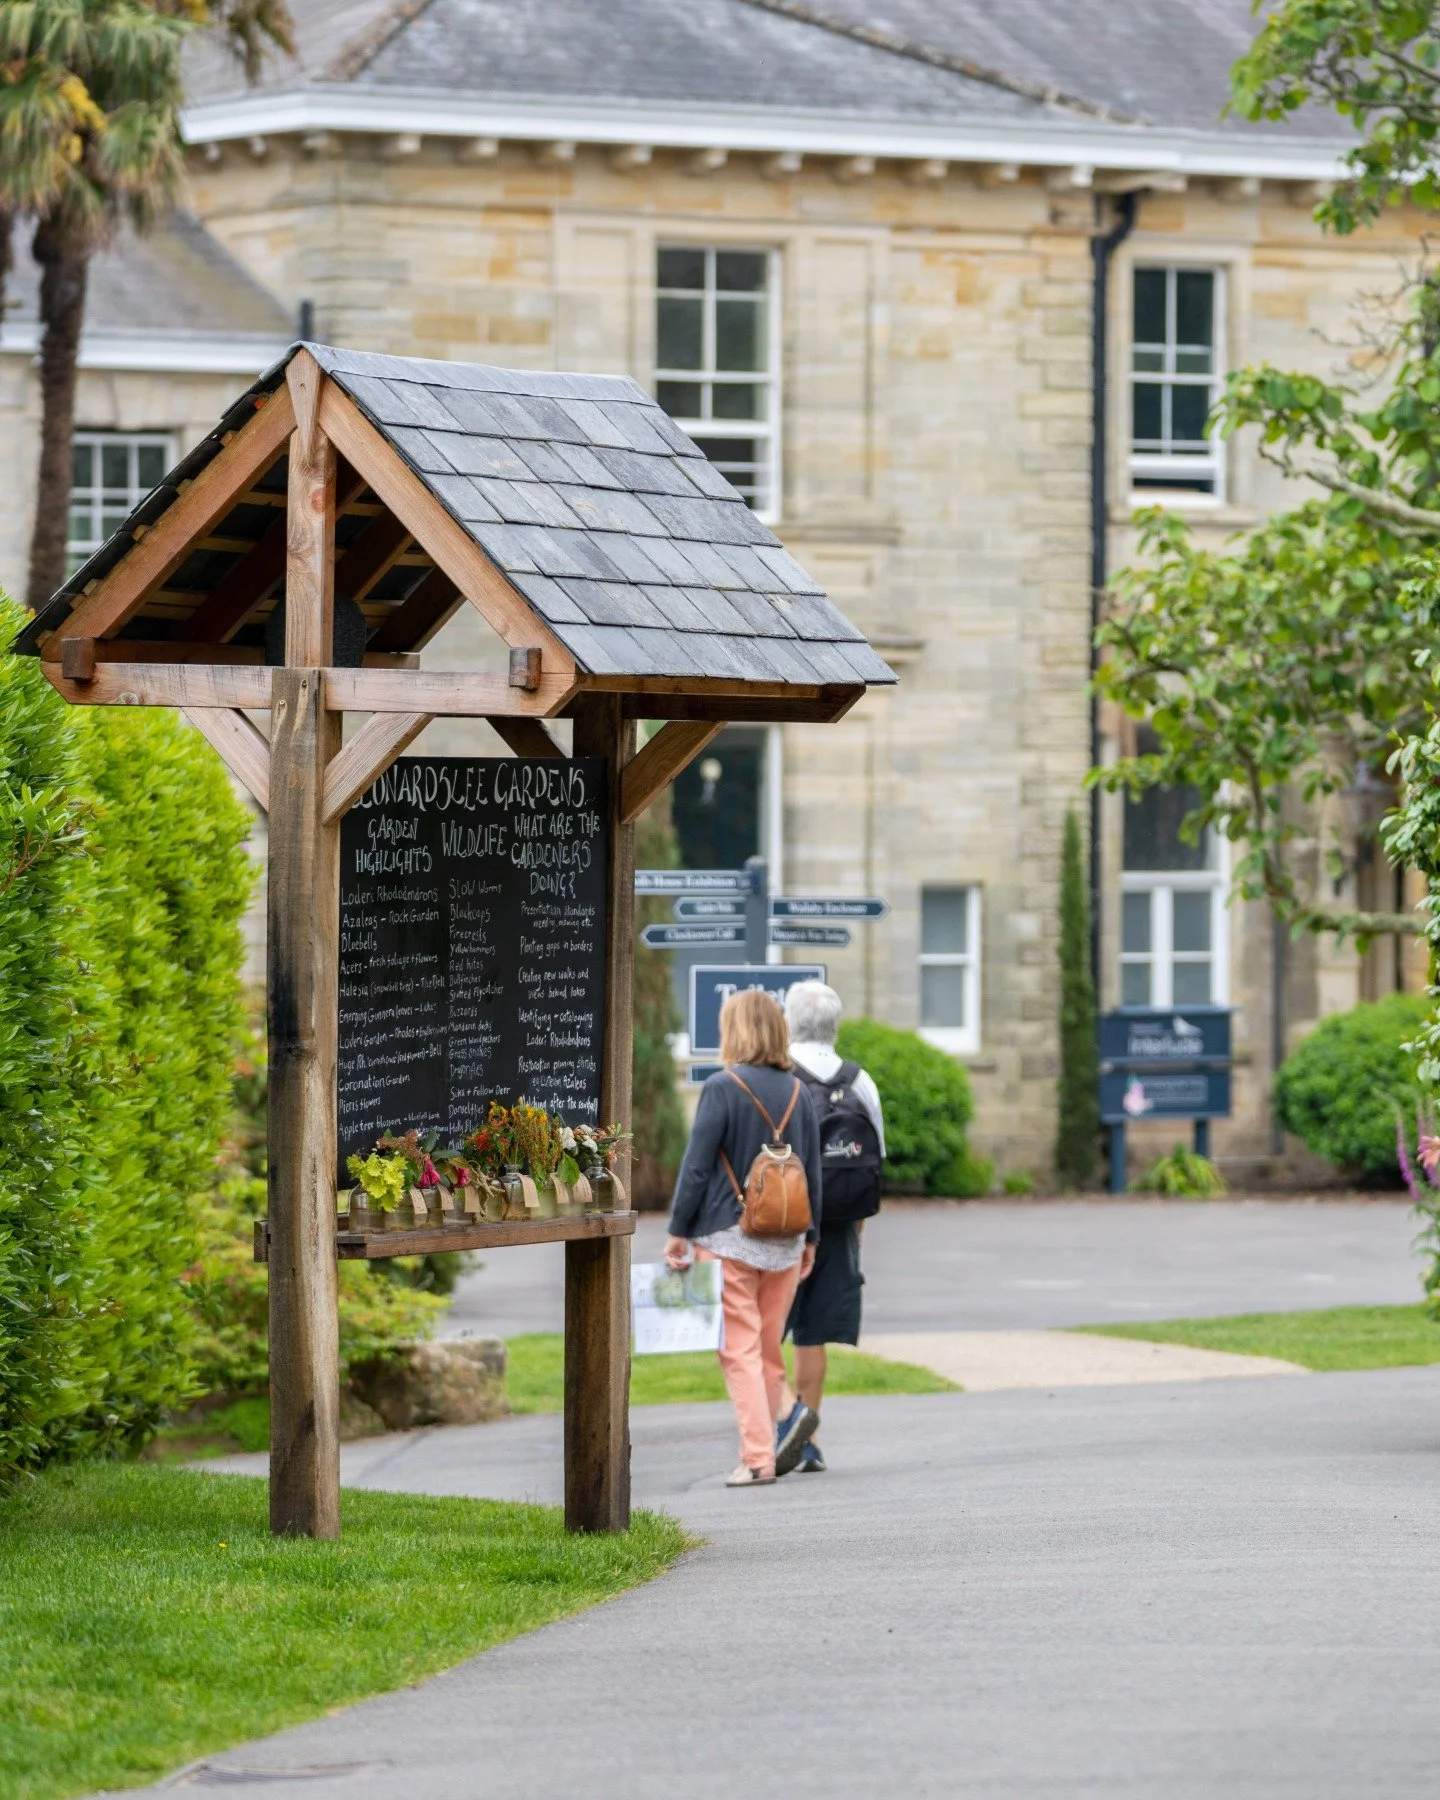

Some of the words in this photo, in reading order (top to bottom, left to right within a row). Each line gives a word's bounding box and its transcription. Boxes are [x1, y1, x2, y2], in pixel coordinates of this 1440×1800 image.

[352, 763, 487, 812] ONARDSLEE
[368, 813, 418, 851] GARDEN
[441, 819, 507, 858] WILDLIFE
[514, 813, 546, 838] WHAT
[550, 814, 573, 839] ARE
[577, 810, 600, 837] THE
[355, 845, 432, 875] HIGHLIGHTS
[511, 840, 592, 873] GARDENERS
[530, 871, 577, 899] DOING?
[342, 909, 378, 929] Azaleas
[341, 931, 378, 952] Bluebells
[339, 1074, 385, 1092] Coronation
